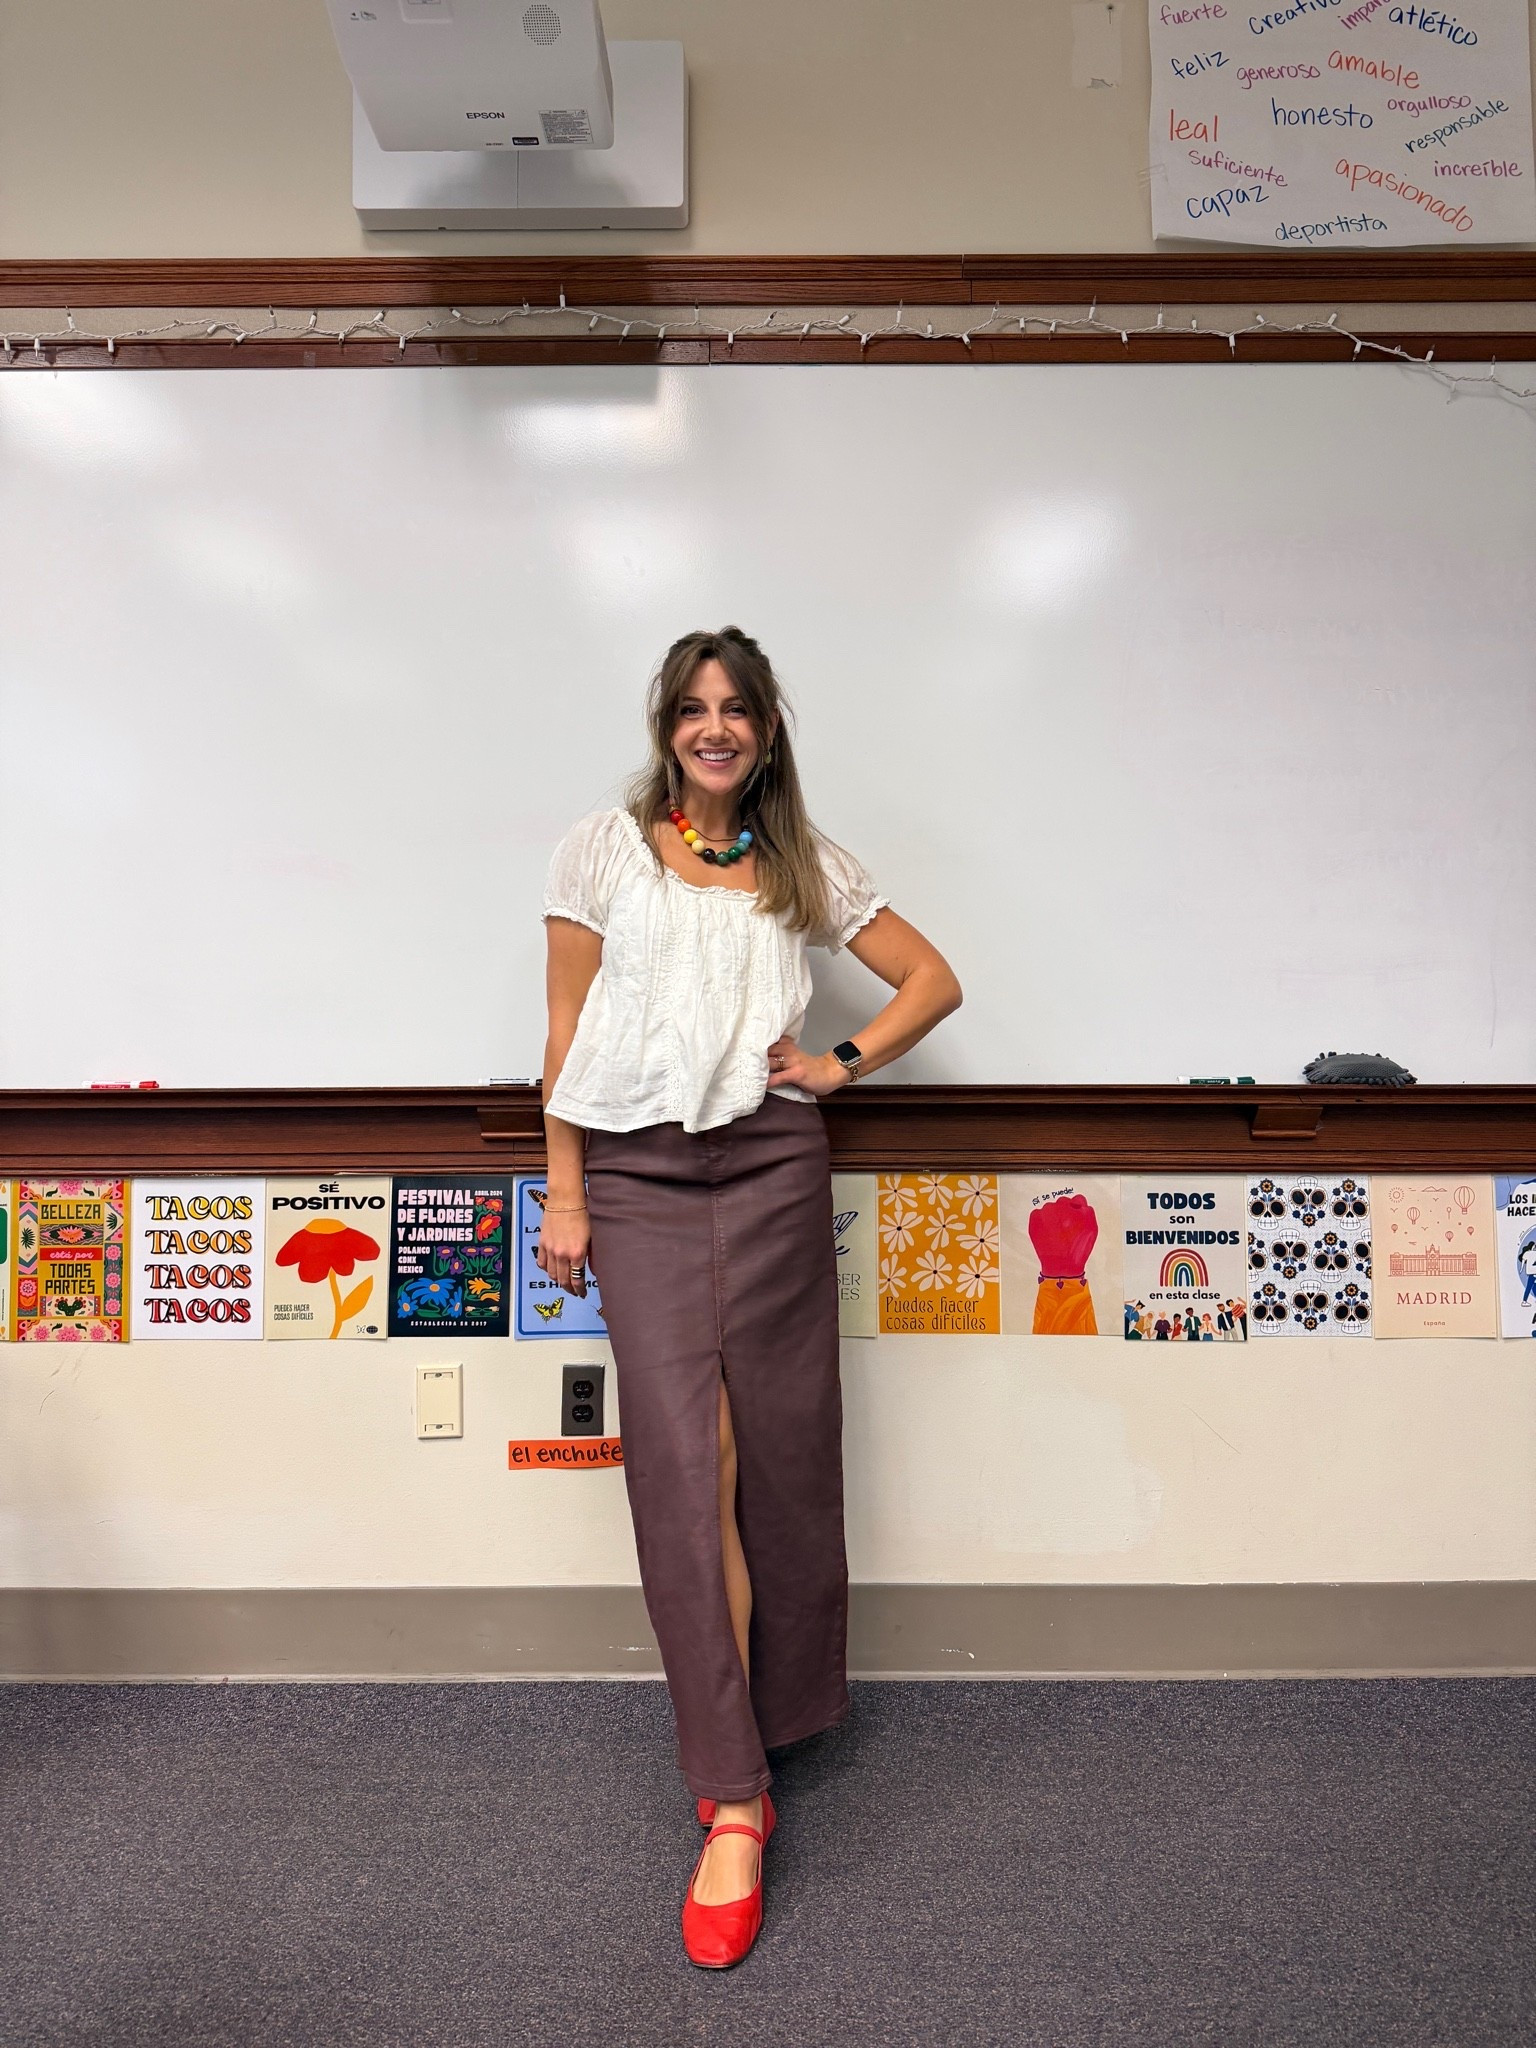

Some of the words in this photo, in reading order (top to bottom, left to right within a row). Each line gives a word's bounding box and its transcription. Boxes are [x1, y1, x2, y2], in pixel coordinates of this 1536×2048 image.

[1159, 3, 1227, 27] fuerte
[1388, 6, 1478, 46] atlético
[1170, 50, 1230, 79] feliz
[1328, 50, 1420, 89] amable
[1236, 62, 1321, 89] generoso
[1271, 98, 1374, 129] honesto
[1387, 95, 1472, 118] orgulloso
[1169, 109, 1219, 143] leal
[1405, 99, 1510, 153] responsable
[1189, 150, 1288, 187] suficiente
[1434, 160, 1523, 177] increíble
[1186, 185, 1269, 219] capaz
[1335, 158, 1474, 232] apasionado
[1275, 213, 1388, 244] deportista
[318, 1181, 339, 1193] SÉ
[272, 1196, 385, 1211] POSITIVO
[398, 1190, 474, 1205] FESTIVAL
[1147, 1193, 1215, 1209] TODOS
[1509, 1193, 1528, 1204] LOS
[41, 1204, 101, 1219] BELLEZA
[145, 1196, 253, 1220] TACOS
[397, 1209, 415, 1223] DE
[419, 1209, 473, 1223] FLORES
[1169, 1214, 1195, 1224] son
[145, 1230, 252, 1254] TACOS
[397, 1228, 405, 1241] Y
[408, 1228, 473, 1241] JARDINES
[1126, 1230, 1240, 1245] BIENVENIDOS
[50, 1251, 73, 1259] está
[74, 1252, 94, 1261] por
[398, 1246, 430, 1254] POLANCO
[50, 1263, 92, 1278] TODAS
[144, 1264, 252, 1289] TACOS
[45, 1279, 95, 1294] PARTES
[1149, 1292, 1163, 1300] en
[1165, 1290, 1189, 1300] esta
[1192, 1289, 1221, 1300] clase
[886, 1296, 934, 1313] Puedes
[940, 1296, 979, 1313] hacer
[1397, 1292, 1472, 1304] MADRID
[143, 1298, 251, 1324] TACOS
[274, 1304, 292, 1312] PUEDES
[294, 1304, 309, 1312] HACER
[886, 1317, 925, 1330] cosas
[511, 1446, 530, 1463] el
[536, 1442, 623, 1463] enchufe
